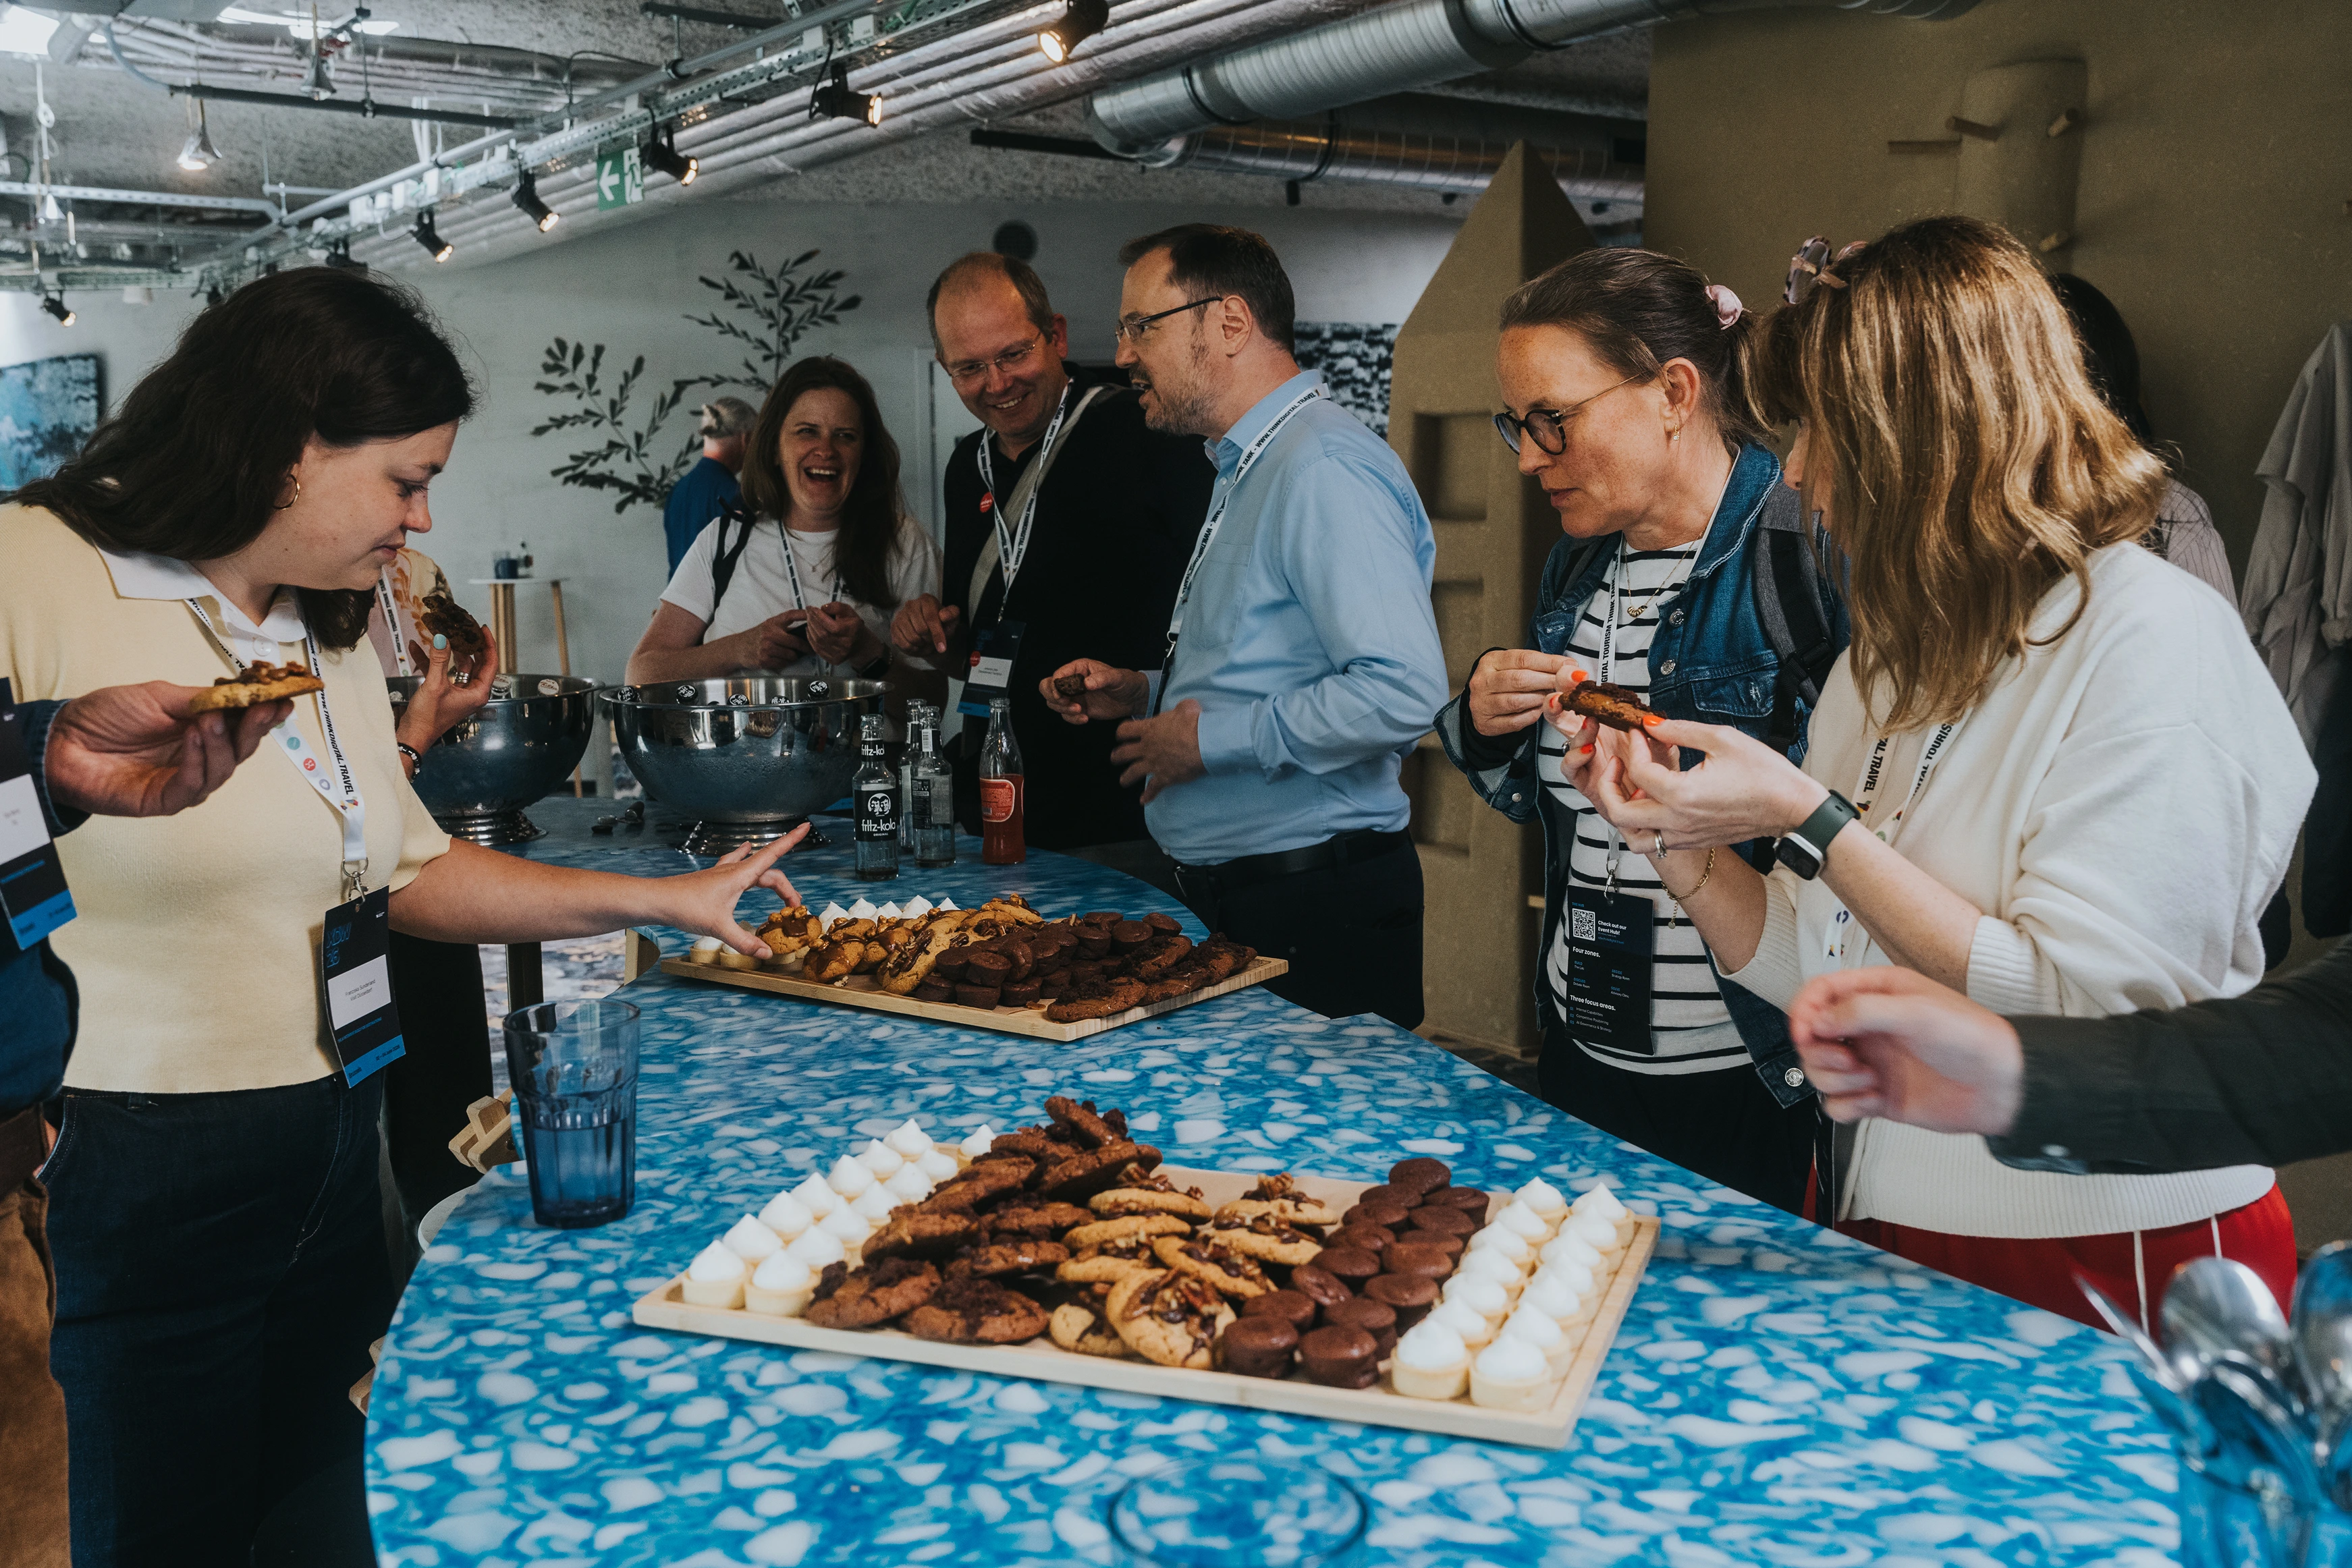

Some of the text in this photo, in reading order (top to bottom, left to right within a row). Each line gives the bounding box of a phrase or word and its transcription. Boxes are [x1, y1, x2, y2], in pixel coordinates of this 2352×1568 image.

[1242, 450, 1255, 466] TANK
[1255, 392, 1316, 448] WWW.THINKDIGITAL.TRAVEL
[1211, 510, 1222, 524] TANK
[1607, 599, 1616, 624] THINK
[1603, 624, 1612, 660] TOURISM
[1601, 661, 1609, 683] GITAL
[1925, 723, 1953, 760] TOURIS
[861, 818, 896, 832] fritz-kola
[1584, 949, 1601, 957] zones.
[1570, 995, 1616, 1011] Three focus areas.
